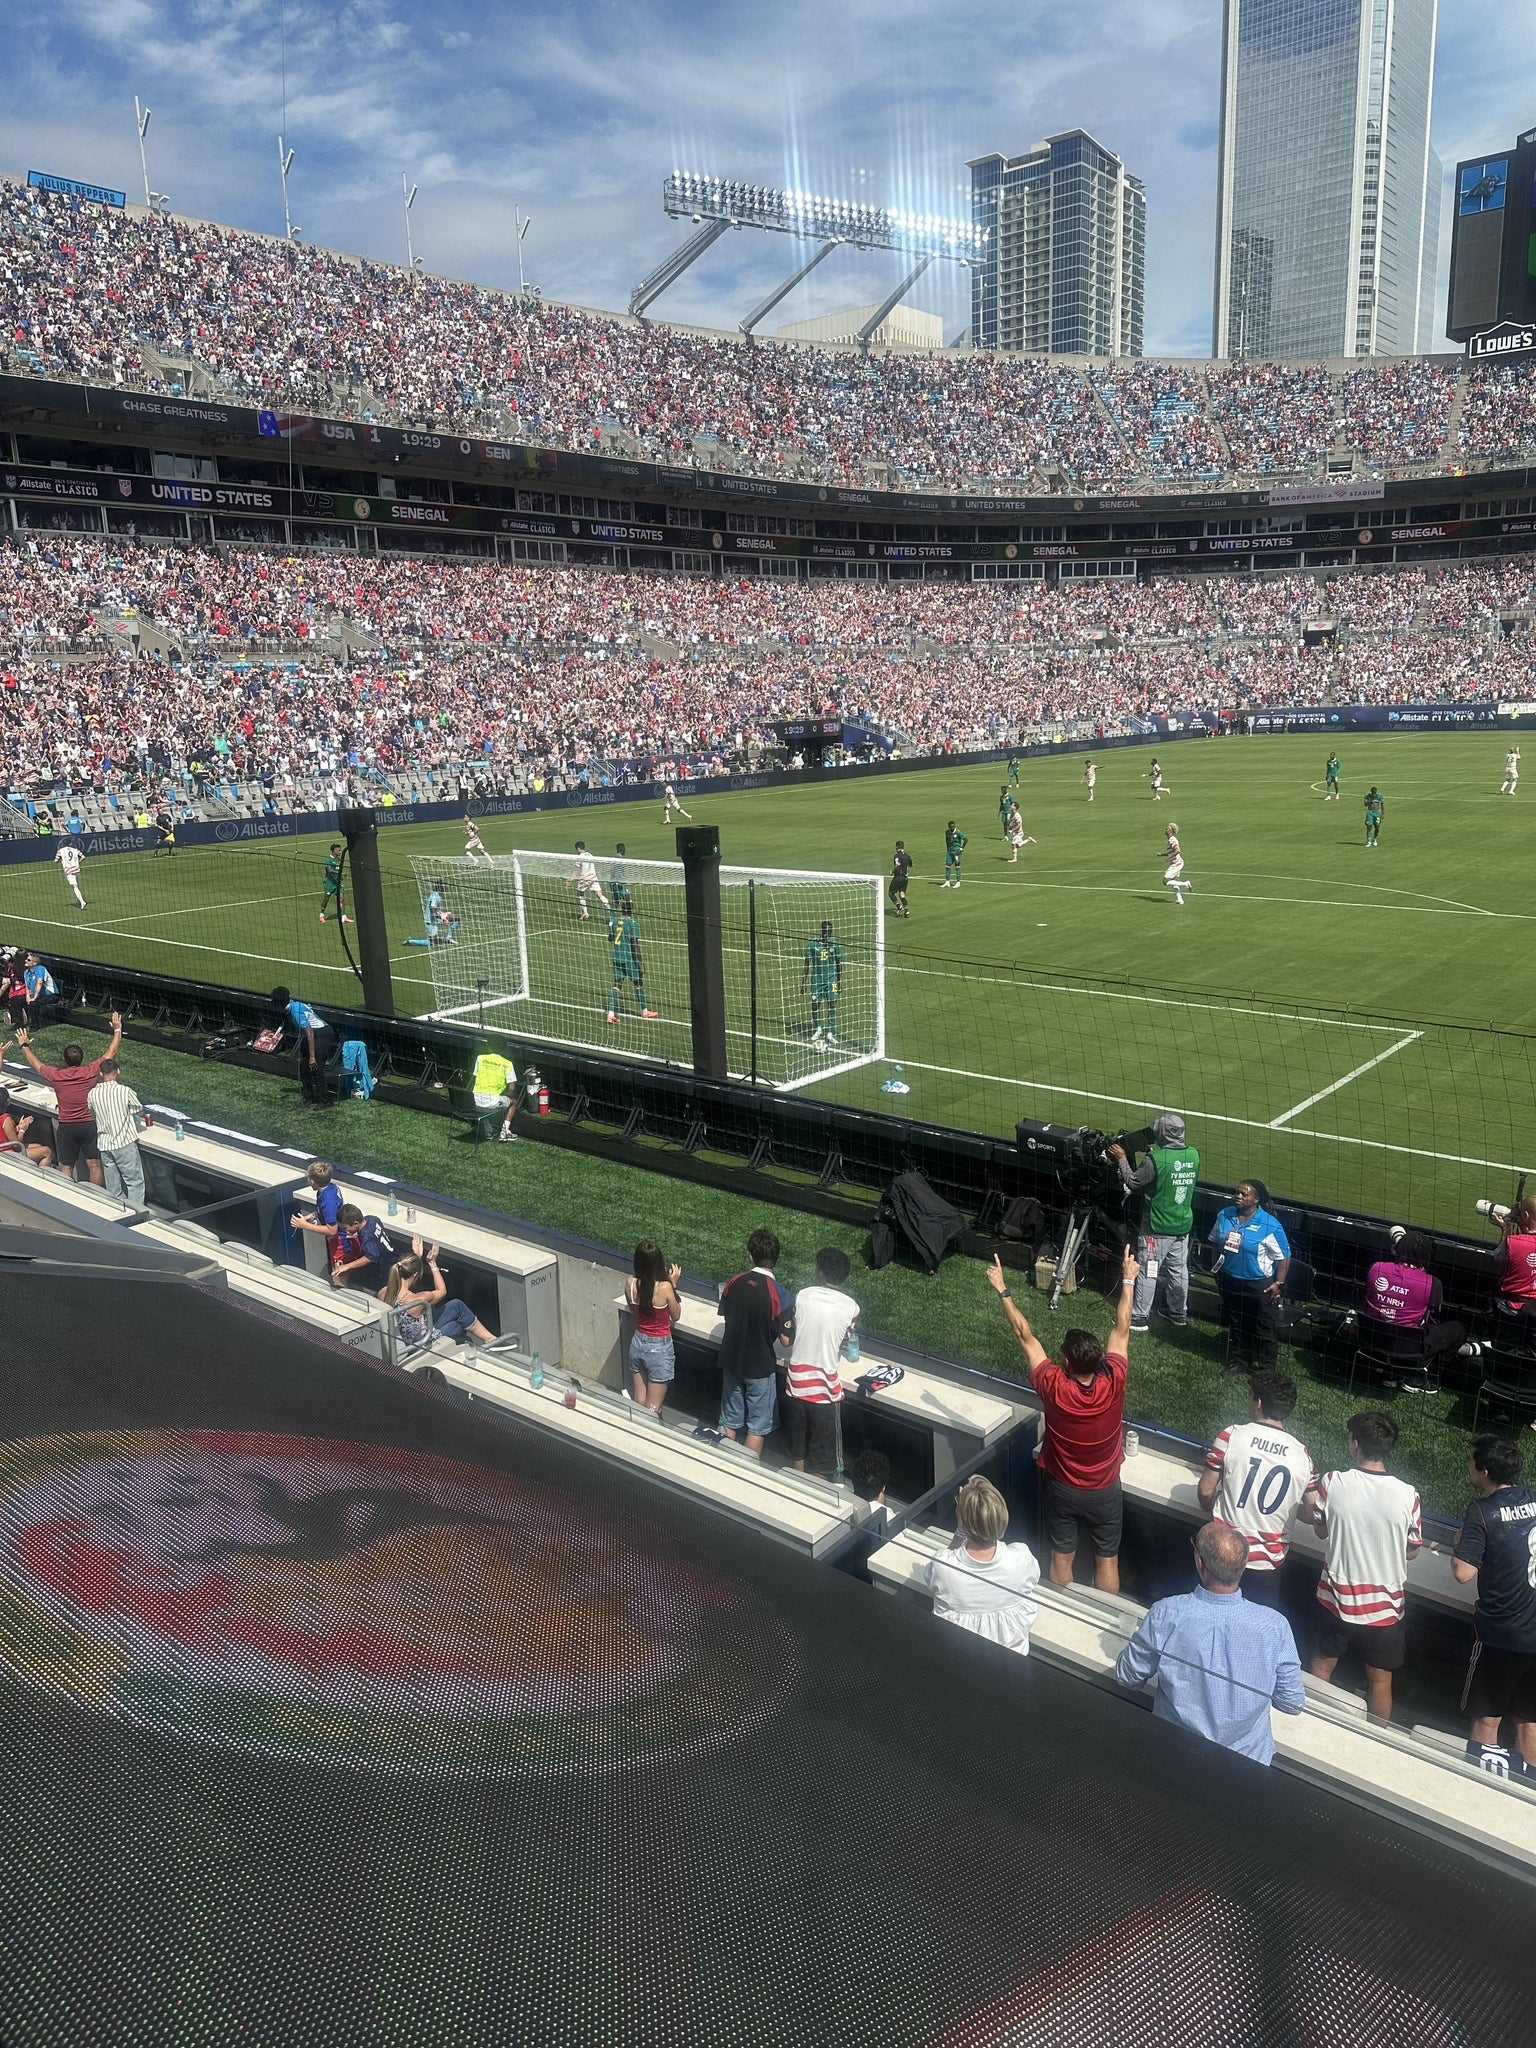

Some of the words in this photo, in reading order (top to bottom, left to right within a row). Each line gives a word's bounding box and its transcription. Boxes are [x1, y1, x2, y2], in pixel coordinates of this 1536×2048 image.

[39, 176, 72, 191] JULIUS
[1477, 331, 1533, 354] LOWE'S
[122, 400, 162, 414] CHASE
[163, 405, 228, 422] GREATNESS
[321, 423, 356, 441] USA
[370, 427, 381, 443] 1
[401, 433, 441, 449] 19:29
[459, 440, 471, 454] 0
[485, 446, 511, 460] SEN
[20, 479, 52, 490] Allstate
[721, 479, 749, 491] UNITED
[750, 483, 778, 494] STATES
[151, 484, 213, 502] UNITED
[216, 490, 273, 507] STATES
[838, 492, 872, 503] SENEGAL
[1349, 489, 1381, 497] STADIUM
[965, 500, 994, 509] UNITED
[995, 501, 1026, 510] STATES
[1099, 500, 1141, 509] SENEGAL
[391, 505, 449, 522] SENEGAL
[590, 524, 628, 537] UNITED
[629, 528, 664, 541] STATES
[1391, 526, 1446, 540] SENEGAL
[736, 538, 776, 550] SENEGAL
[1209, 540, 1250, 550] UNITED
[1252, 537, 1293, 548] STATES
[883, 546, 917, 556] UNITED
[918, 547, 952, 556] STATES
[1033, 546, 1079, 556] SENEGAL
[1400, 713, 1429, 722] Allstate
[823, 723, 840, 733] SEN
[743, 776, 769, 787] Allstate
[582, 790, 615, 803] Allstate
[485, 799, 522, 813] Allstate
[240, 821, 290, 837] Allstate
[87, 835, 145, 853] Allstate
[67, 851, 74, 862] 9
[615, 926, 623, 946] 2
[1037, 1142, 1056, 1152] SPORTS
[1172, 1178, 1194, 1186] HOLDER
[1178, 1171, 1196, 1179] RIGHTS
[530, 1273, 547, 1287] ROW
[1390, 1285, 1410, 1296] AT&T
[1376, 1293, 1386, 1302] TV
[1386, 1296, 1405, 1308] NRH
[348, 1333, 368, 1347] ROW
[369, 1330, 375, 1339] 2
[1250, 1436, 1290, 1457] PULISIC
[1236, 1456, 1292, 1516] 10
